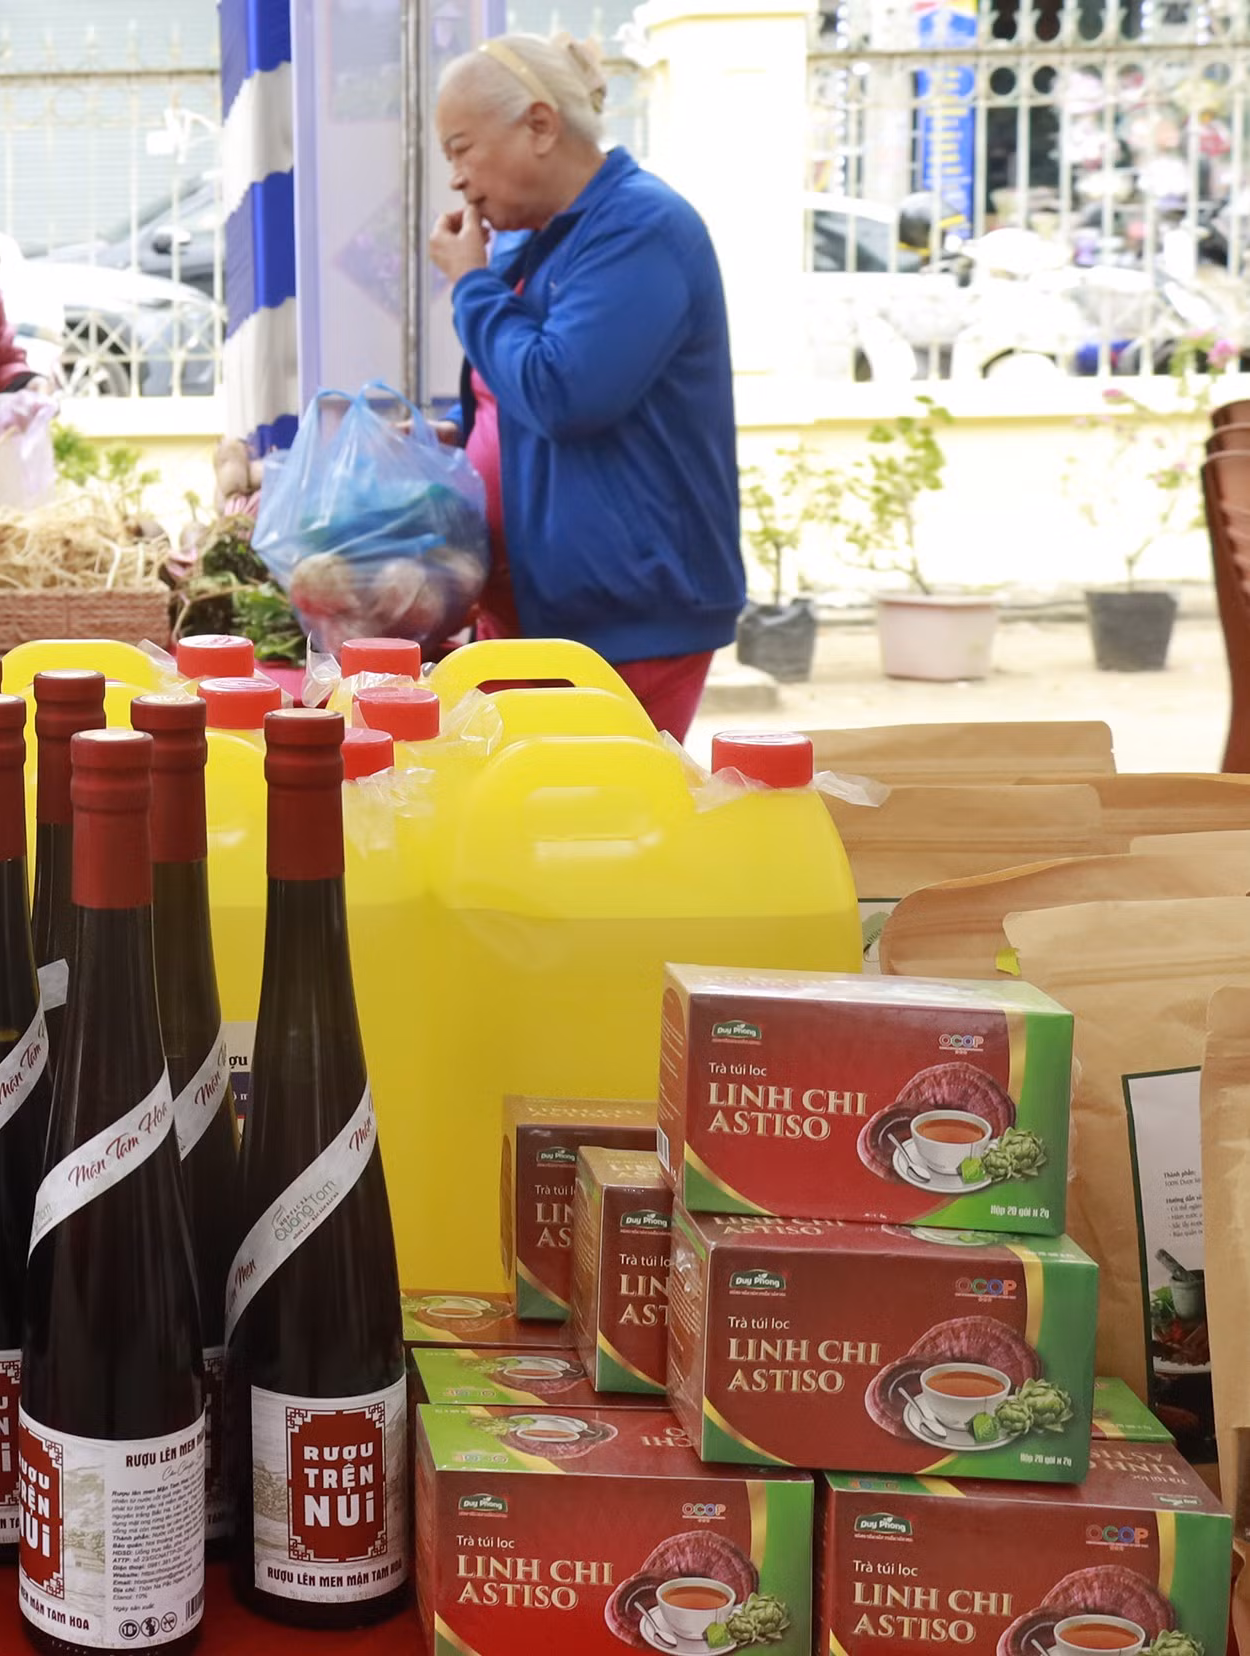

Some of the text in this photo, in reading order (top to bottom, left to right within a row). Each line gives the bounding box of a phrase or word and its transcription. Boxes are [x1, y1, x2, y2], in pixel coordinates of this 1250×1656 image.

[717, 1025, 757, 1038] Duy Phong
[938, 1034, 984, 1048] OCOP
[229, 1055, 249, 1069] ợu
[708, 1062, 767, 1079] Trà túi lọc
[707, 1082, 868, 1117] LINH CHI
[707, 1109, 831, 1141] ASTISO
[106, 1132, 140, 1161] Tam
[535, 1185, 568, 1196] Trà túi
[625, 1213, 668, 1228] Duy Phong
[990, 1204, 1005, 1218] Hộp
[1006, 1205, 1017, 1217] 20
[1018, 1206, 1031, 1219] gói
[1039, 1208, 1050, 1221] 2g
[619, 1254, 638, 1267] Trà
[640, 1254, 657, 1267] túi
[735, 1274, 780, 1289] Duy Phong
[955, 1276, 1017, 1294] OCOP
[727, 1315, 790, 1331] Trà túi lọc
[727, 1338, 881, 1366] LINH CHI
[727, 1367, 845, 1394] ASTISO
[126, 1441, 196, 1469] RƯỢU LÊN MEN
[303, 1441, 374, 1462] RƯỢU
[20, 1461, 50, 1489] ƯỢU
[303, 1463, 374, 1489] TRÊN
[20, 1481, 50, 1519] RÊN
[463, 1498, 503, 1512] Duy Phong
[682, 1502, 727, 1517] OCOP
[860, 1518, 907, 1534] Duy Phong
[1085, 1524, 1149, 1544] OCOP
[456, 1535, 515, 1551] Trà túi lọc
[267, 1566, 294, 1584] RƯỢU
[297, 1571, 316, 1587] LÊN
[319, 1577, 343, 1588] MEN
[347, 1571, 369, 1589] MẬN
[371, 1566, 390, 1581] TAM
[456, 1554, 615, 1586] LINH CHI
[852, 1559, 918, 1577] Trà túi lọc
[457, 1582, 579, 1610] ASTISO
[852, 1582, 1013, 1617] LINH CHI
[46, 1607, 66, 1625] TAM
[69, 1615, 90, 1631] HOA
[852, 1612, 976, 1643] ASTISO
